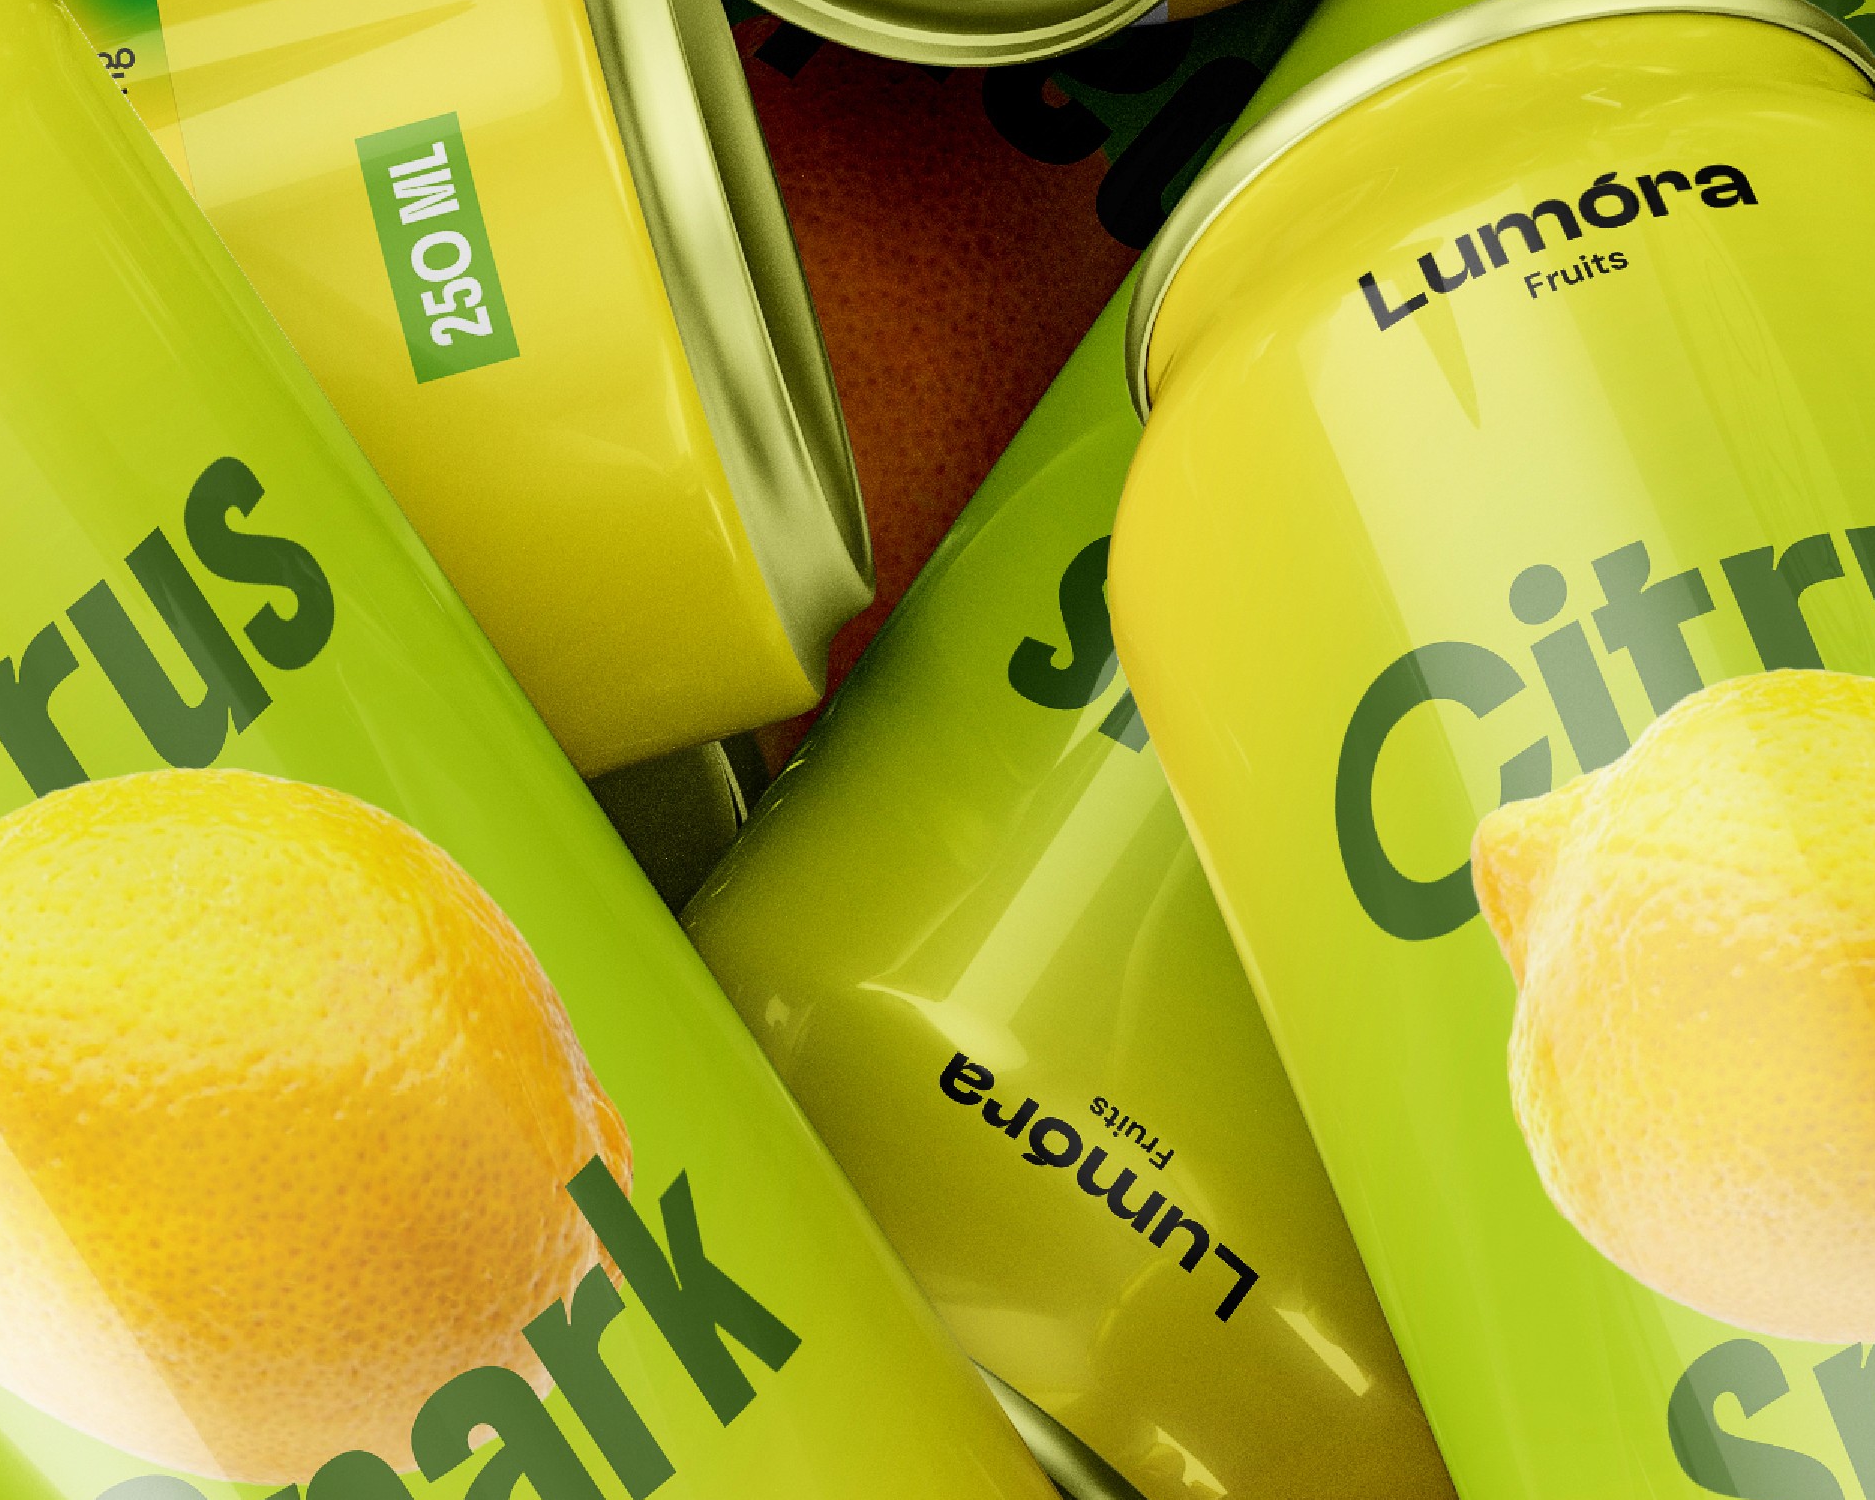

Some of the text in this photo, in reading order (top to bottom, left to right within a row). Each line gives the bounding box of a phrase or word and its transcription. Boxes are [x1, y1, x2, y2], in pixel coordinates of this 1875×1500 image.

[388, 141, 495, 347] 250 ML
[1359, 160, 1759, 331] Lumóra
[1522, 244, 1630, 300] Fruits
[936, 1052, 1259, 1323] Lumóra
[1089, 1094, 1174, 1169] Fruits
